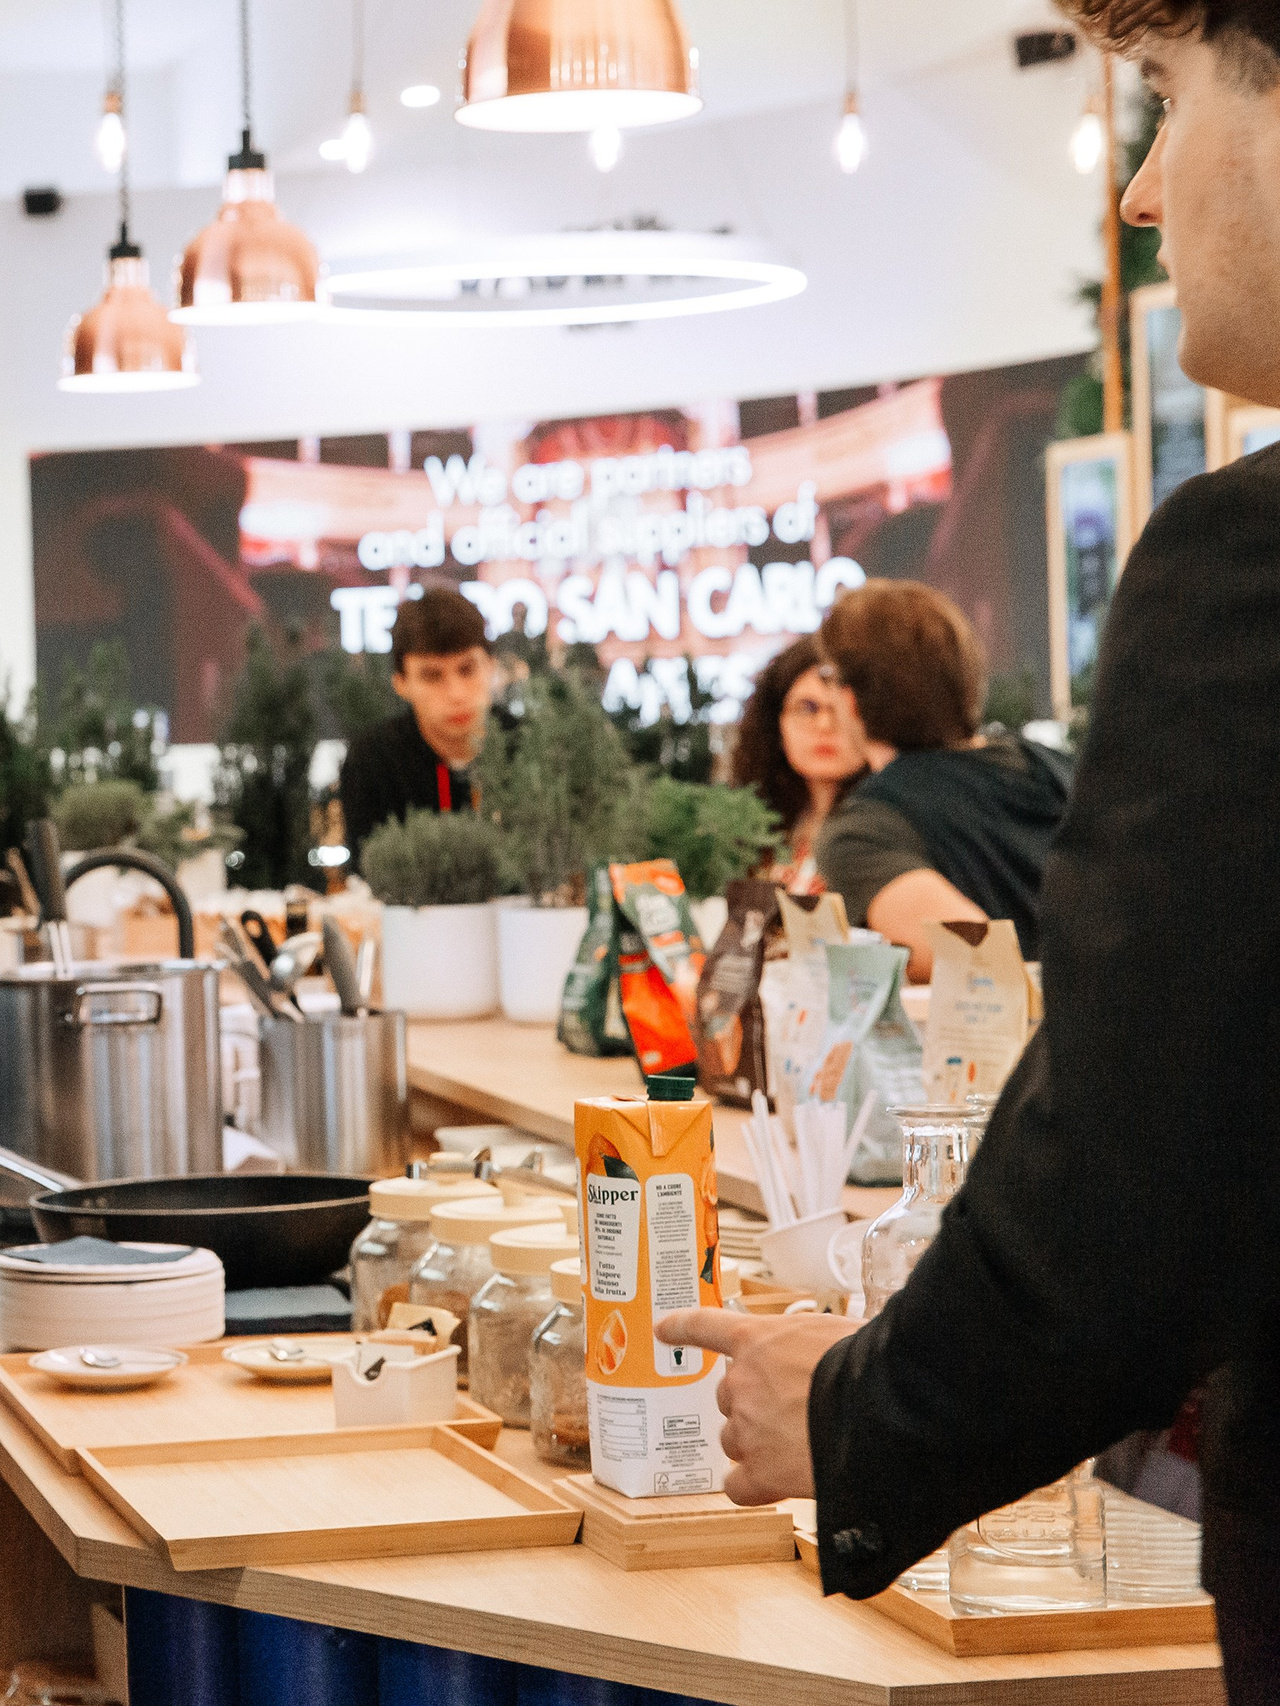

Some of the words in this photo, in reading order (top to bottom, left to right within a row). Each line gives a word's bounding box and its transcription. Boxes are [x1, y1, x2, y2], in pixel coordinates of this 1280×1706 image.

[424, 454, 507, 507] We
[512, 461, 584, 504] are
[591, 444, 752, 512] partners
[358, 510, 445, 571] and
[772, 480, 819, 544] of
[556, 560, 680, 643] SAN
[588, 1184, 638, 1205] Skipper
